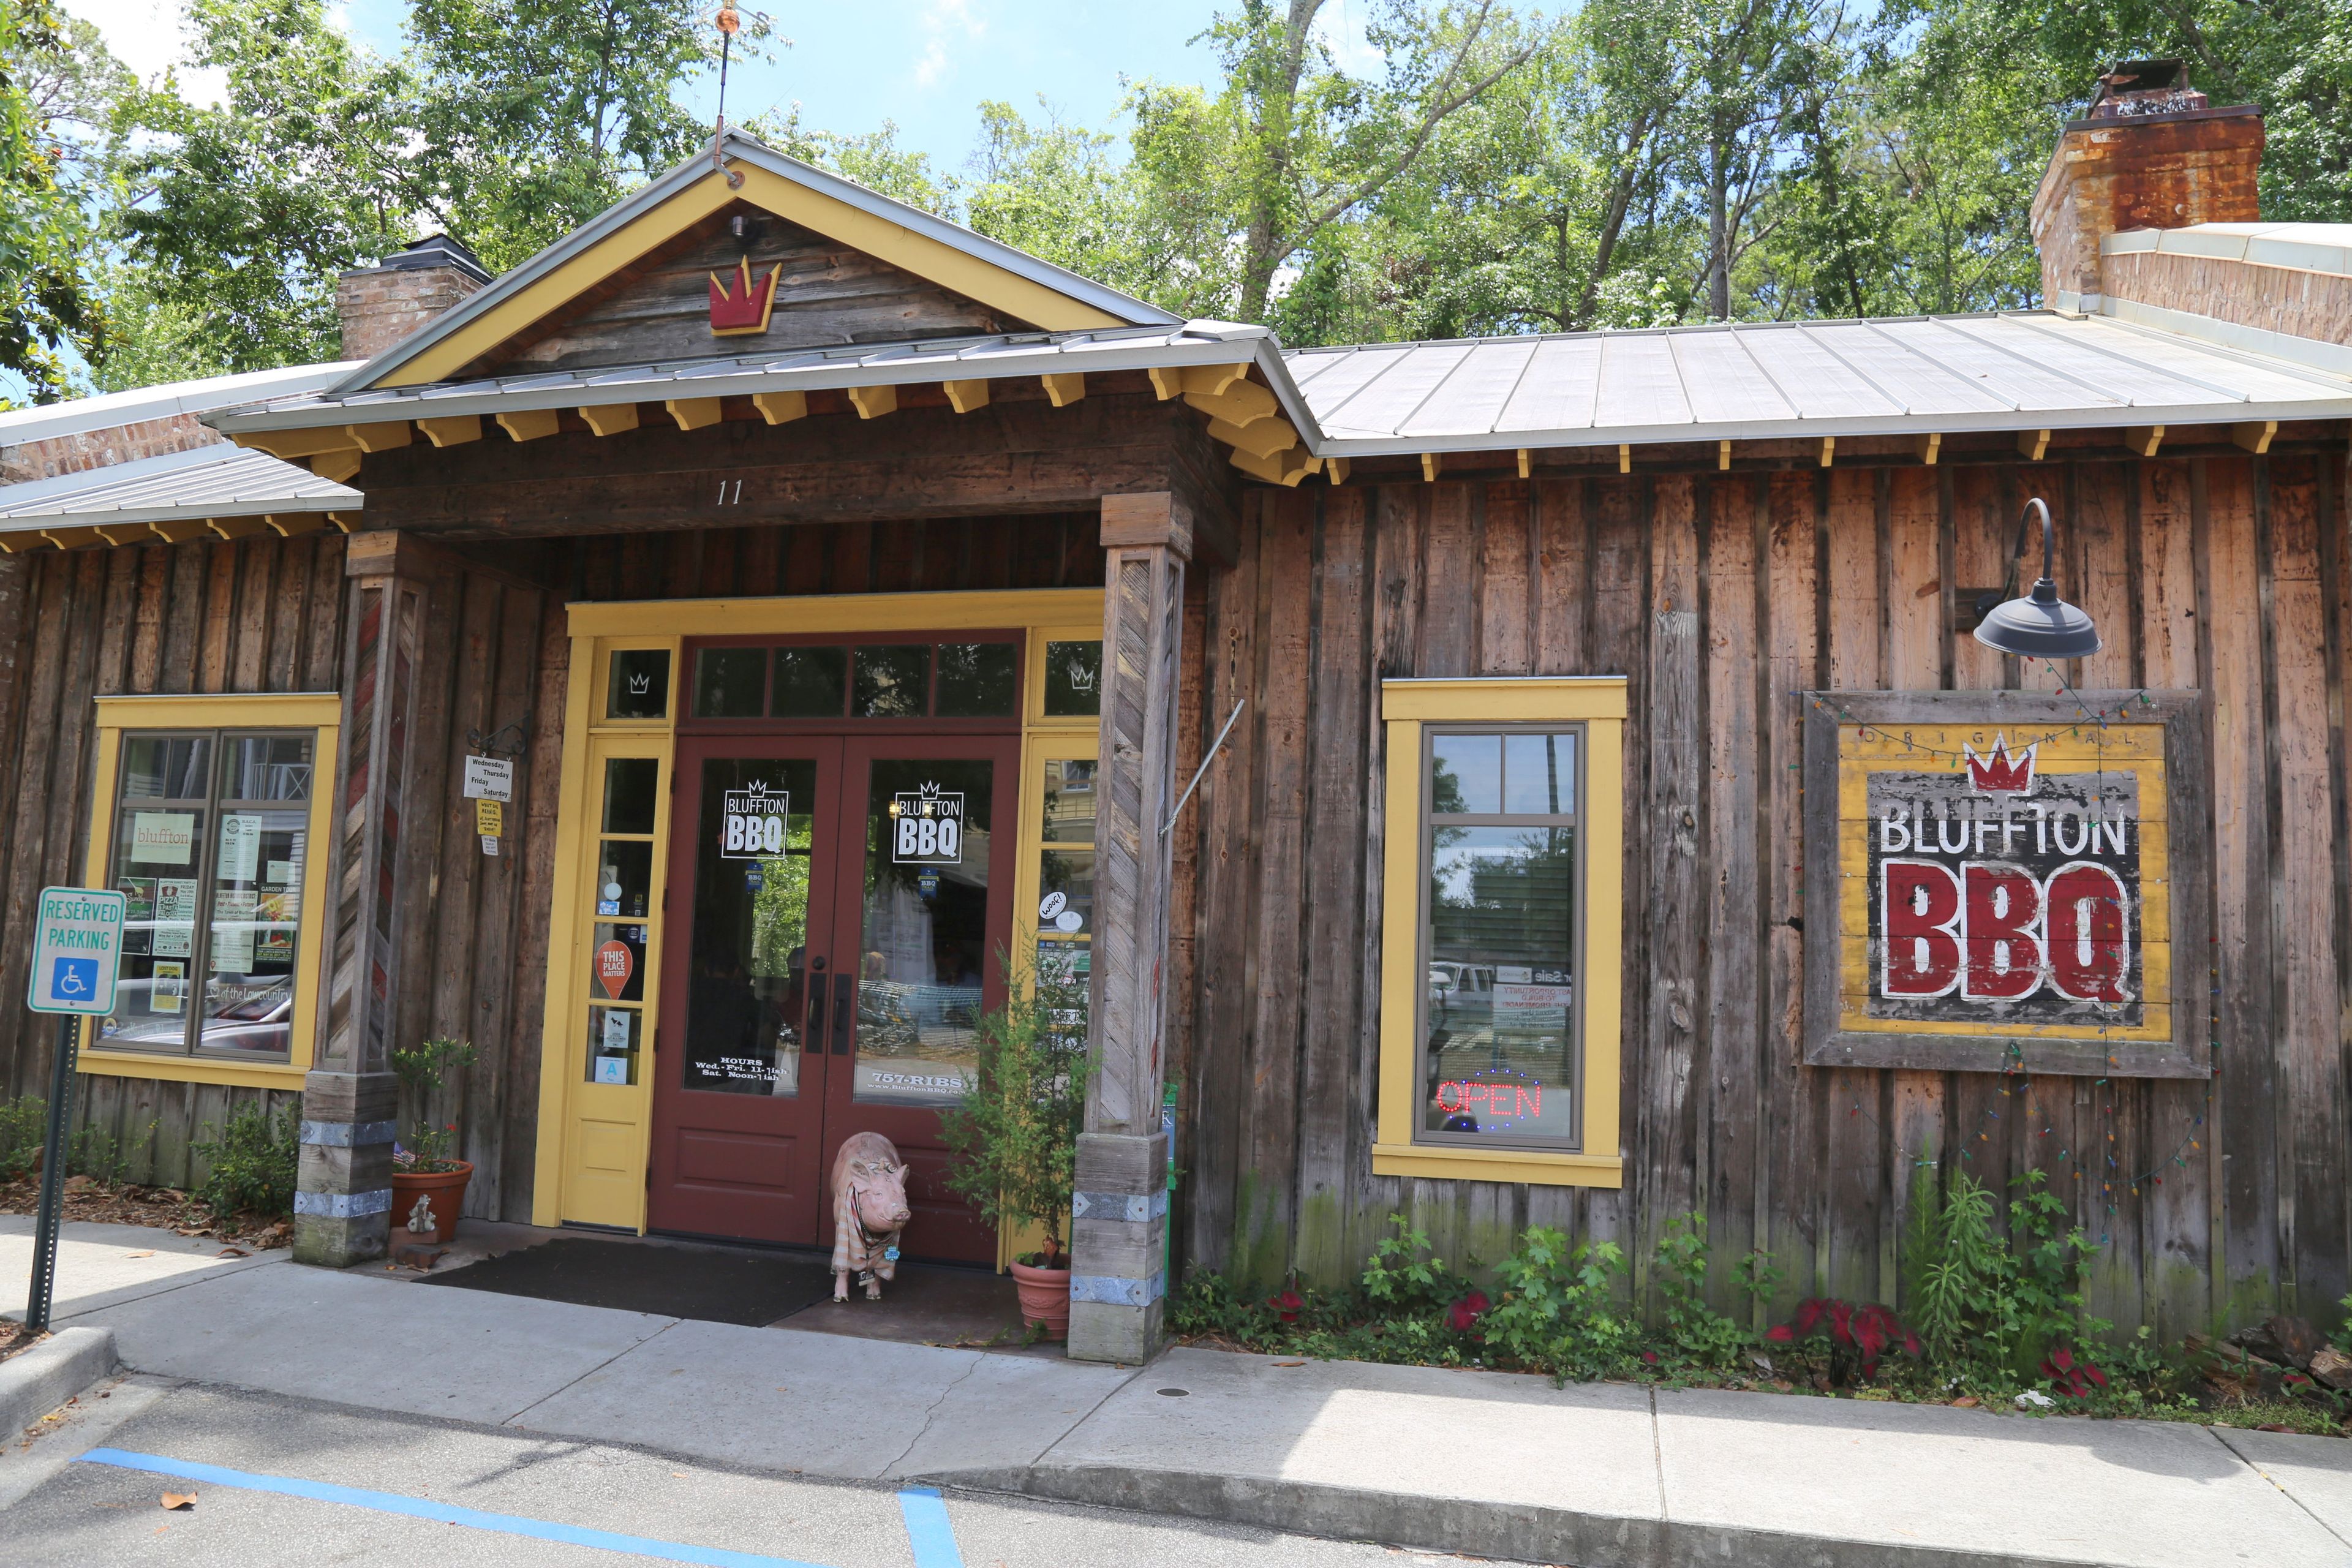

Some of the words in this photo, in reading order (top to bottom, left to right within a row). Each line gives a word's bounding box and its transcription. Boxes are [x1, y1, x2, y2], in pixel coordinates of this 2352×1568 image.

[717, 480, 742, 505] 11
[1864, 731, 2133, 744] ORIGINAL
[472, 759, 504, 769] Wednesday
[471, 777, 489, 786] Friday
[483, 769, 509, 779] Thursday
[484, 788, 508, 798] Saturday
[728, 799, 785, 813] BLUFFTON
[899, 801, 959, 816] BLUFFTON
[137, 827, 189, 844] bluffton
[726, 815, 782, 854] BBQ
[1880, 801, 2125, 856] BLUFFTON
[898, 818, 957, 858] BBQ
[45, 900, 118, 922] RESERVED
[48, 928, 110, 950] PARKING
[1880, 858, 2136, 1011] BBQ
[603, 951, 624, 962] THIS
[221, 987, 229, 999] of
[230, 987, 243, 999] the
[244, 987, 292, 1002] Lowcountry
[606, 1062, 617, 1076] A
[720, 1057, 763, 1066] HOURS
[872, 1072, 963, 1088] 757-RIBS
[867, 1084, 966, 1095] www.BlufftonBBQ.com
[1437, 1080, 1542, 1117] OPEN
